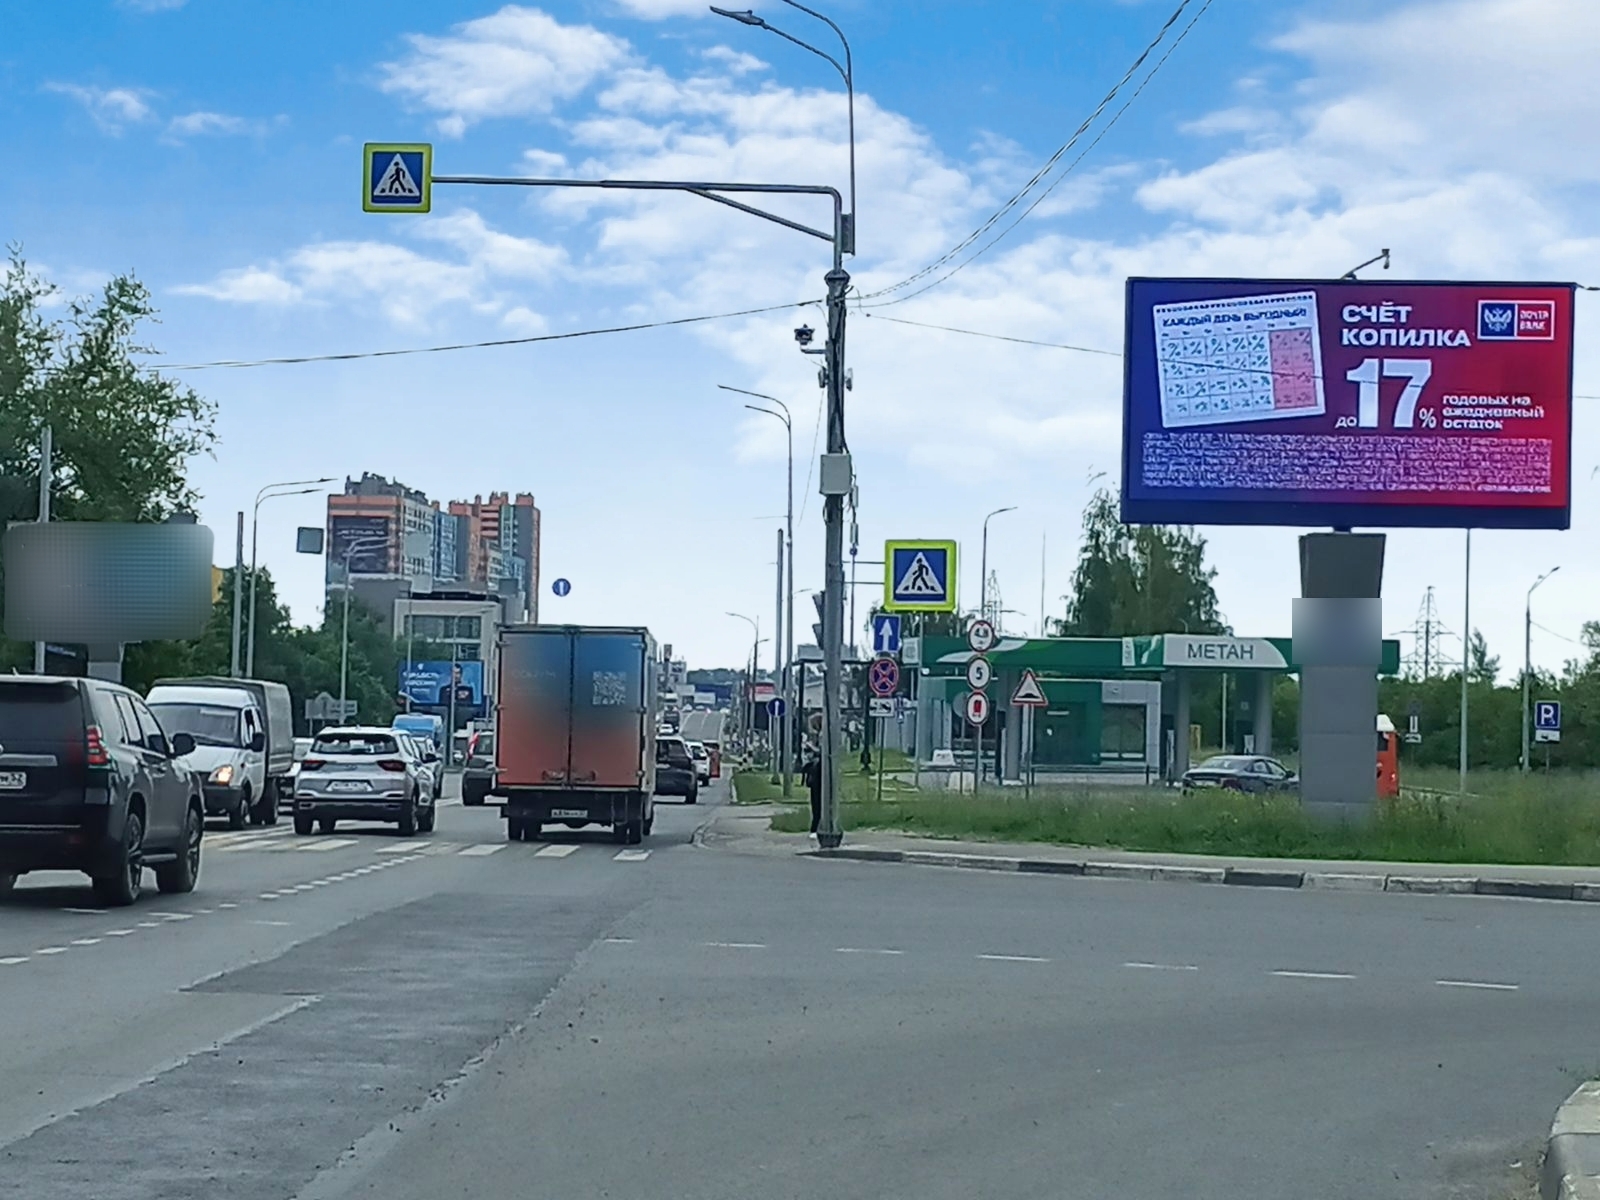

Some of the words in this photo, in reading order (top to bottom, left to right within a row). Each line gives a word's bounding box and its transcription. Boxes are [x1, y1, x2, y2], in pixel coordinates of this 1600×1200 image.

[1342, 301, 1412, 323] СЧЁТ
[1342, 328, 1471, 347] КОПИЛКА
[1442, 395, 1509, 406] годовых
[1511, 395, 1532, 406] на
[1442, 419, 1504, 430] остаток
[1187, 643, 1254, 661] МЕТАН
[975, 666, 984, 681] 5
